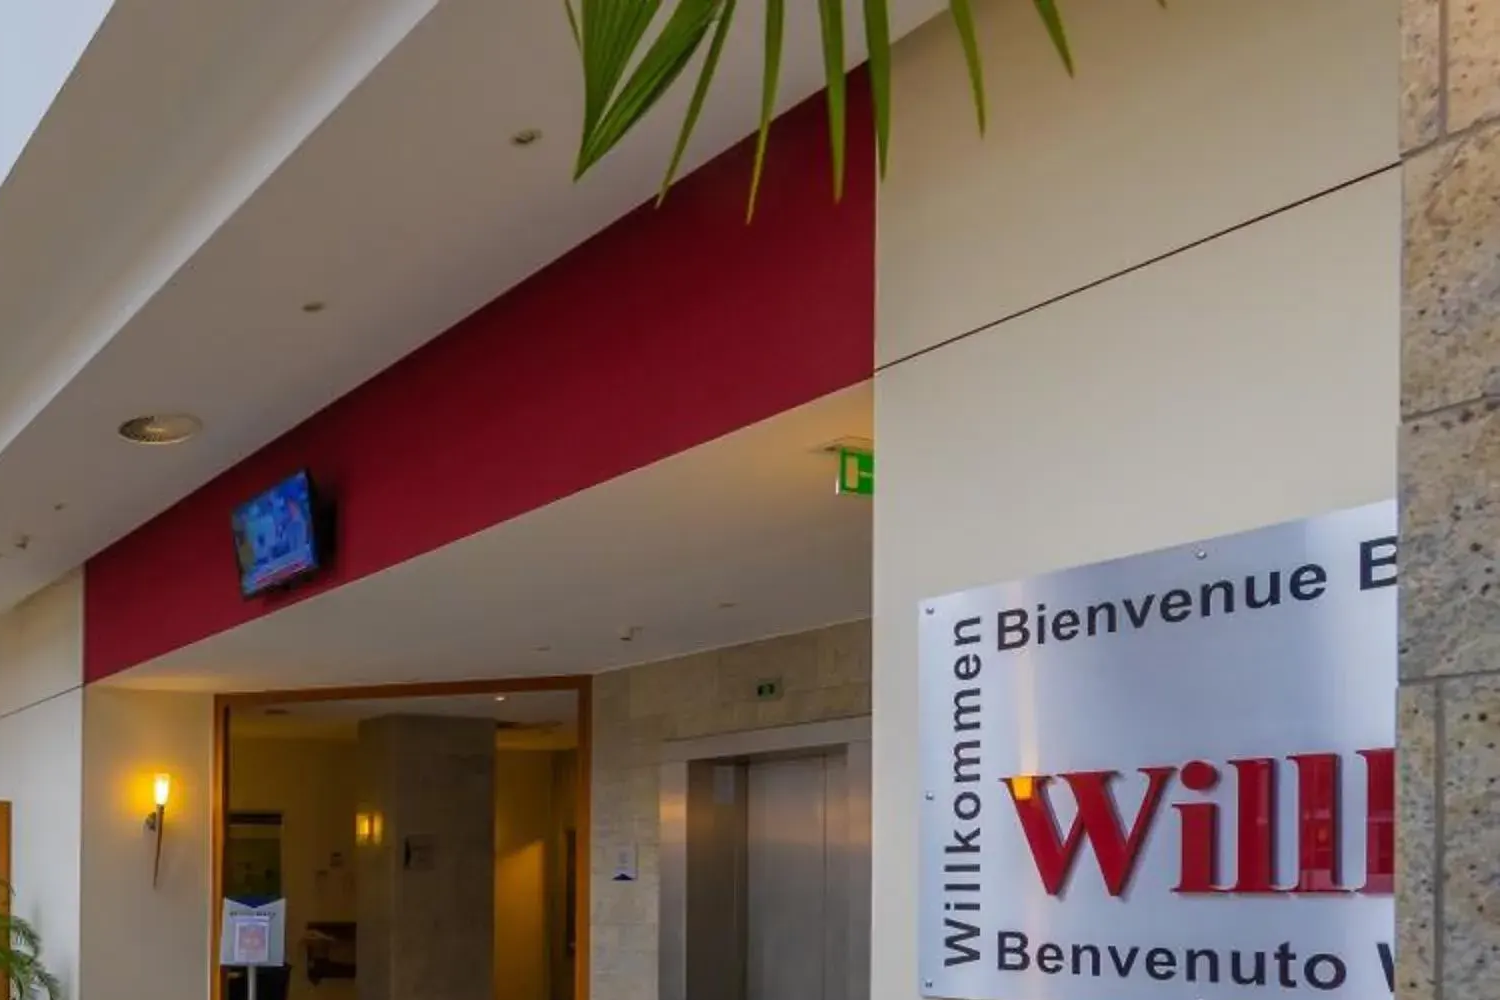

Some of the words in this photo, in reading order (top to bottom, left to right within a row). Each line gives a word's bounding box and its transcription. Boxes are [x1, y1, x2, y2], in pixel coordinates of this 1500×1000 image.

[996, 562, 1327, 652] Bienvenue
[943, 615, 982, 968] Willkommen
[996, 930, 1347, 991] Benvenuto
